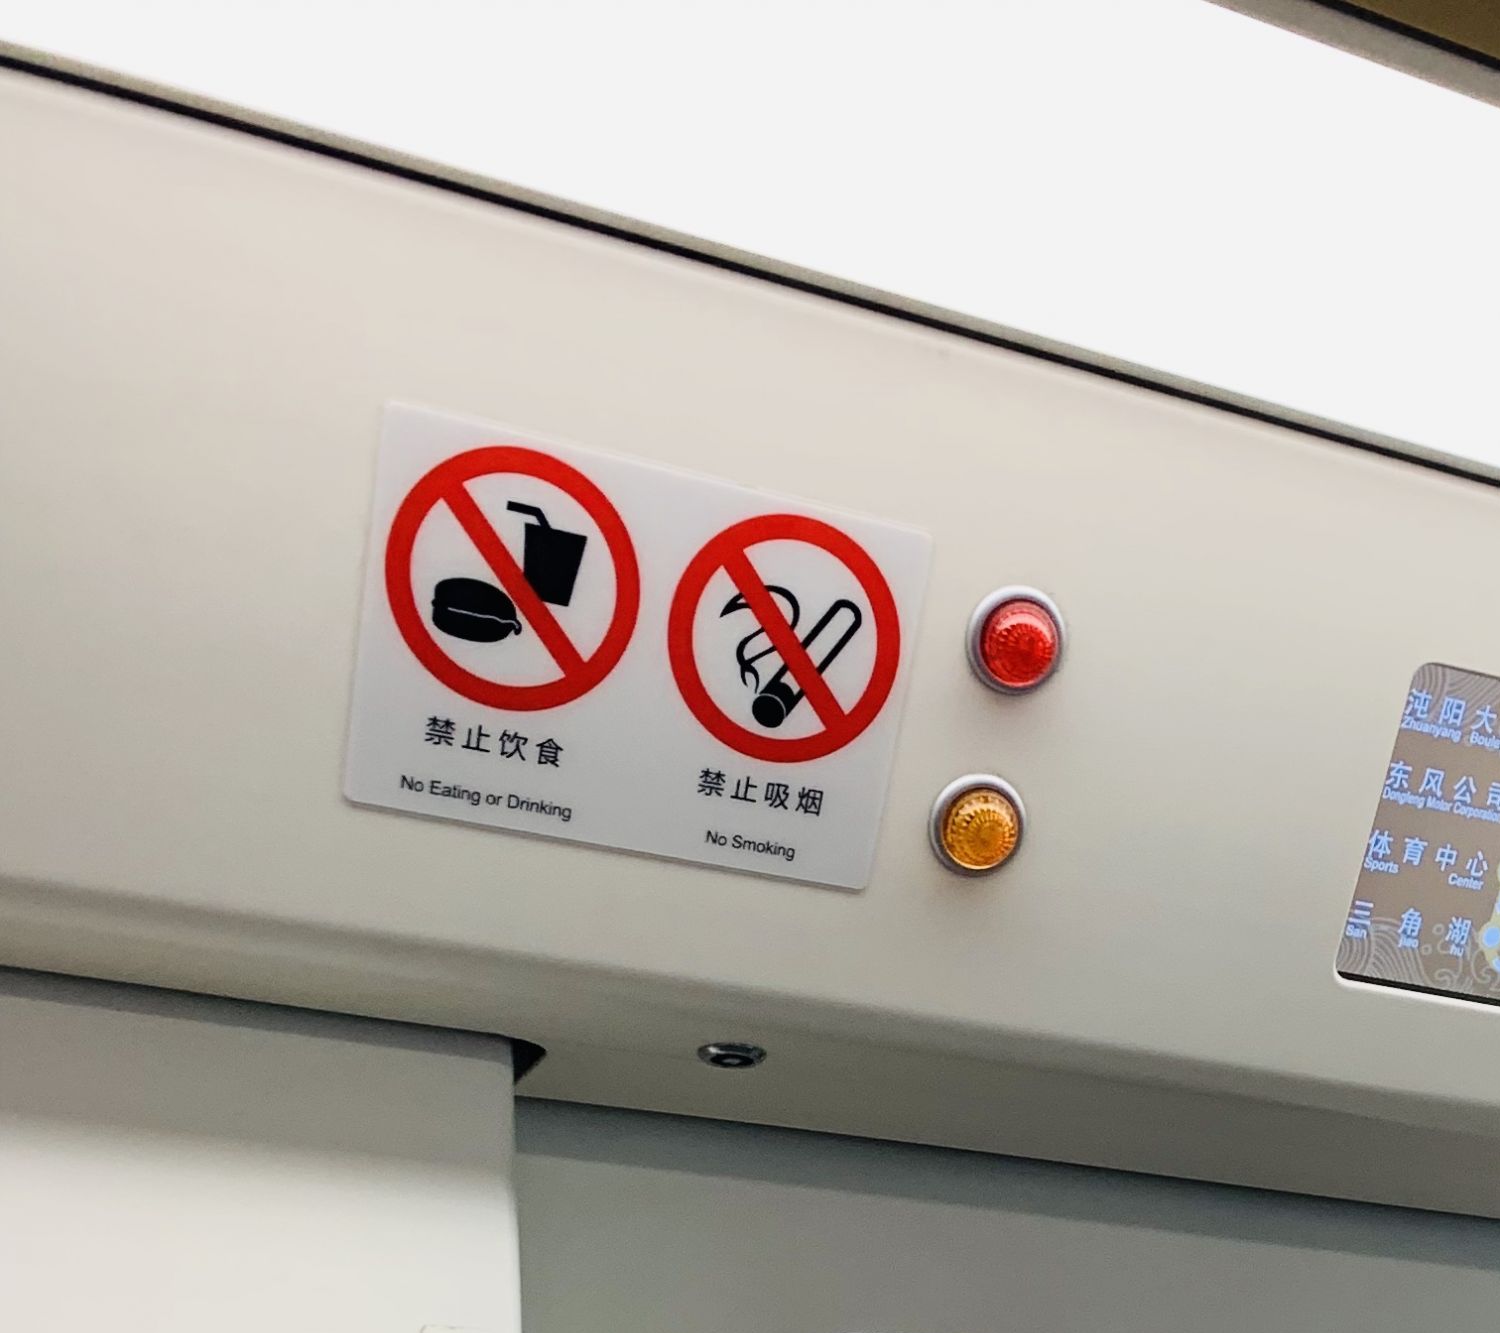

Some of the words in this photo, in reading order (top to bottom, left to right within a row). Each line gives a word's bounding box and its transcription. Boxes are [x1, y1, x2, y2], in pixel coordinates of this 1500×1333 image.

[424, 716, 564, 768] 禁止饮食
[401, 775, 425, 795] No
[429, 779, 482, 807] Eating
[485, 790, 503, 806] or
[507, 793, 573, 822] Drinking
[697, 768, 824, 817] 禁止吸烟
[706, 829, 728, 848] No
[731, 833, 796, 862] Smoking
[1364, 857, 1399, 874] Sports
[1368, 829, 1489, 879] 体育中心
[1449, 873, 1484, 891] Center
[1348, 900, 1472, 945] 三角湖
